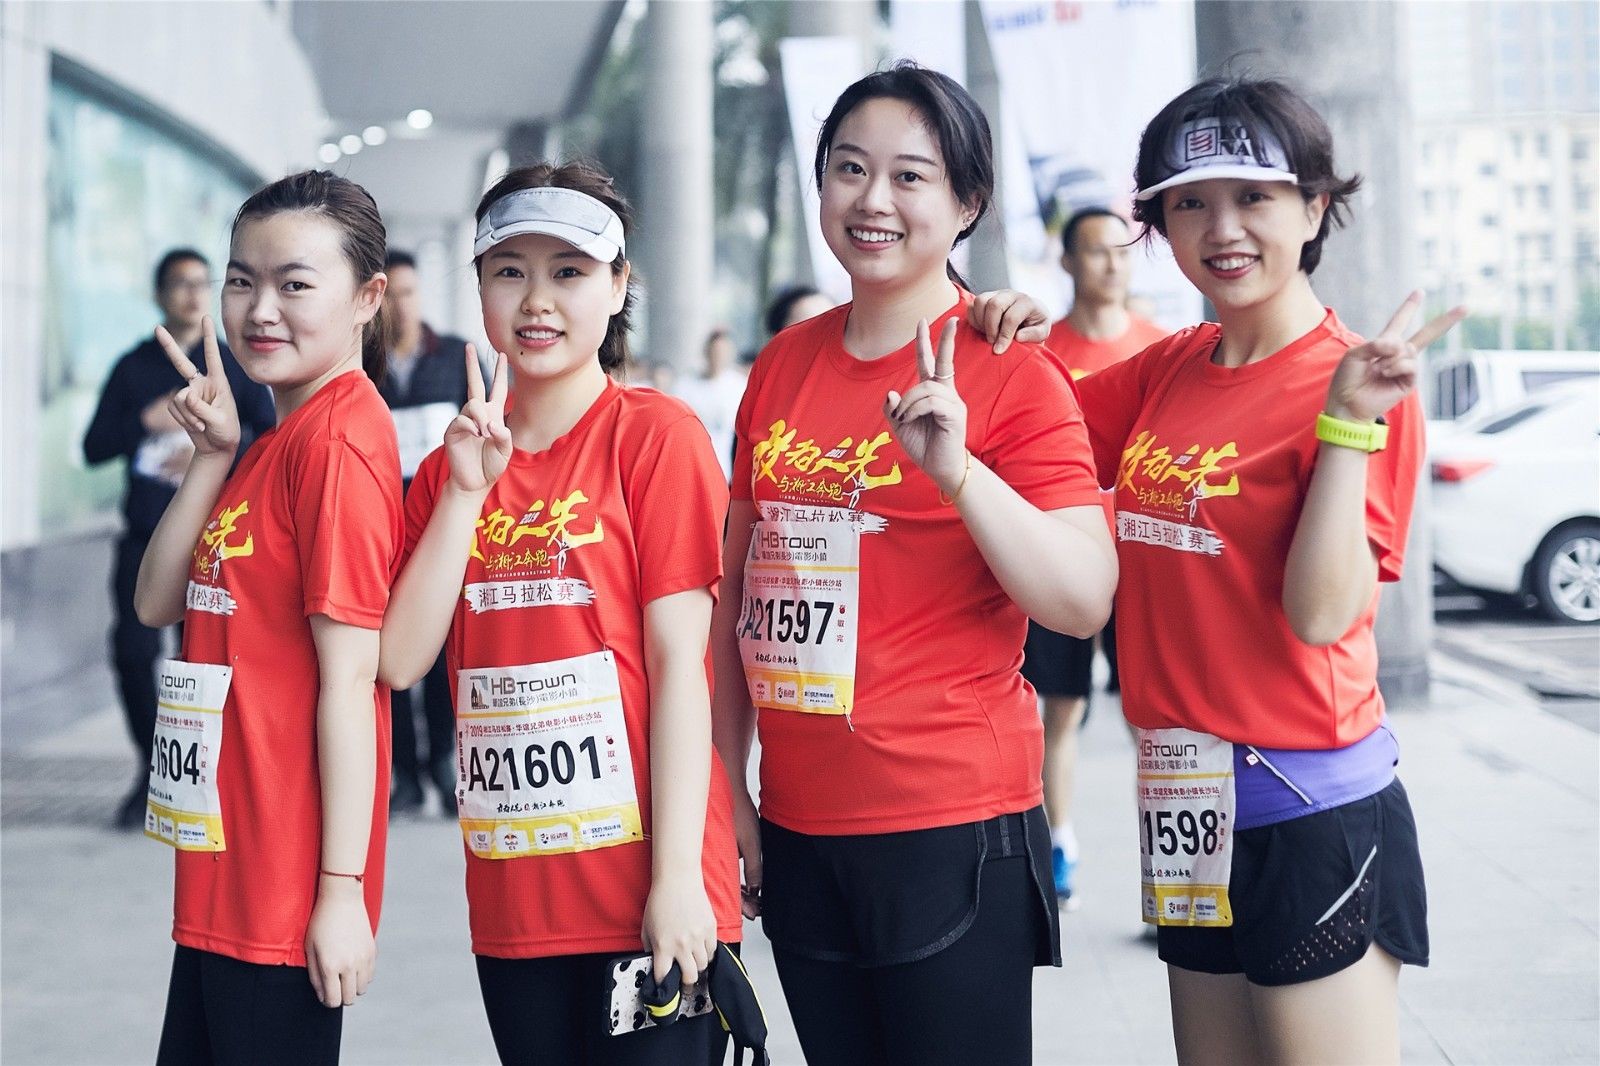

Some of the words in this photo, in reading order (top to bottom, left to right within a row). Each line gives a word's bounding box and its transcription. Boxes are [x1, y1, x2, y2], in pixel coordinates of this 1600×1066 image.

[470, 490, 604, 561] 为人先
[1124, 517, 1203, 550] 湘江马拉松赛
[741, 596, 834, 644] A21597
[151, 734, 200, 785] 1604
[468, 735, 601, 792] A21601
[1141, 809, 1218, 855] 1598
